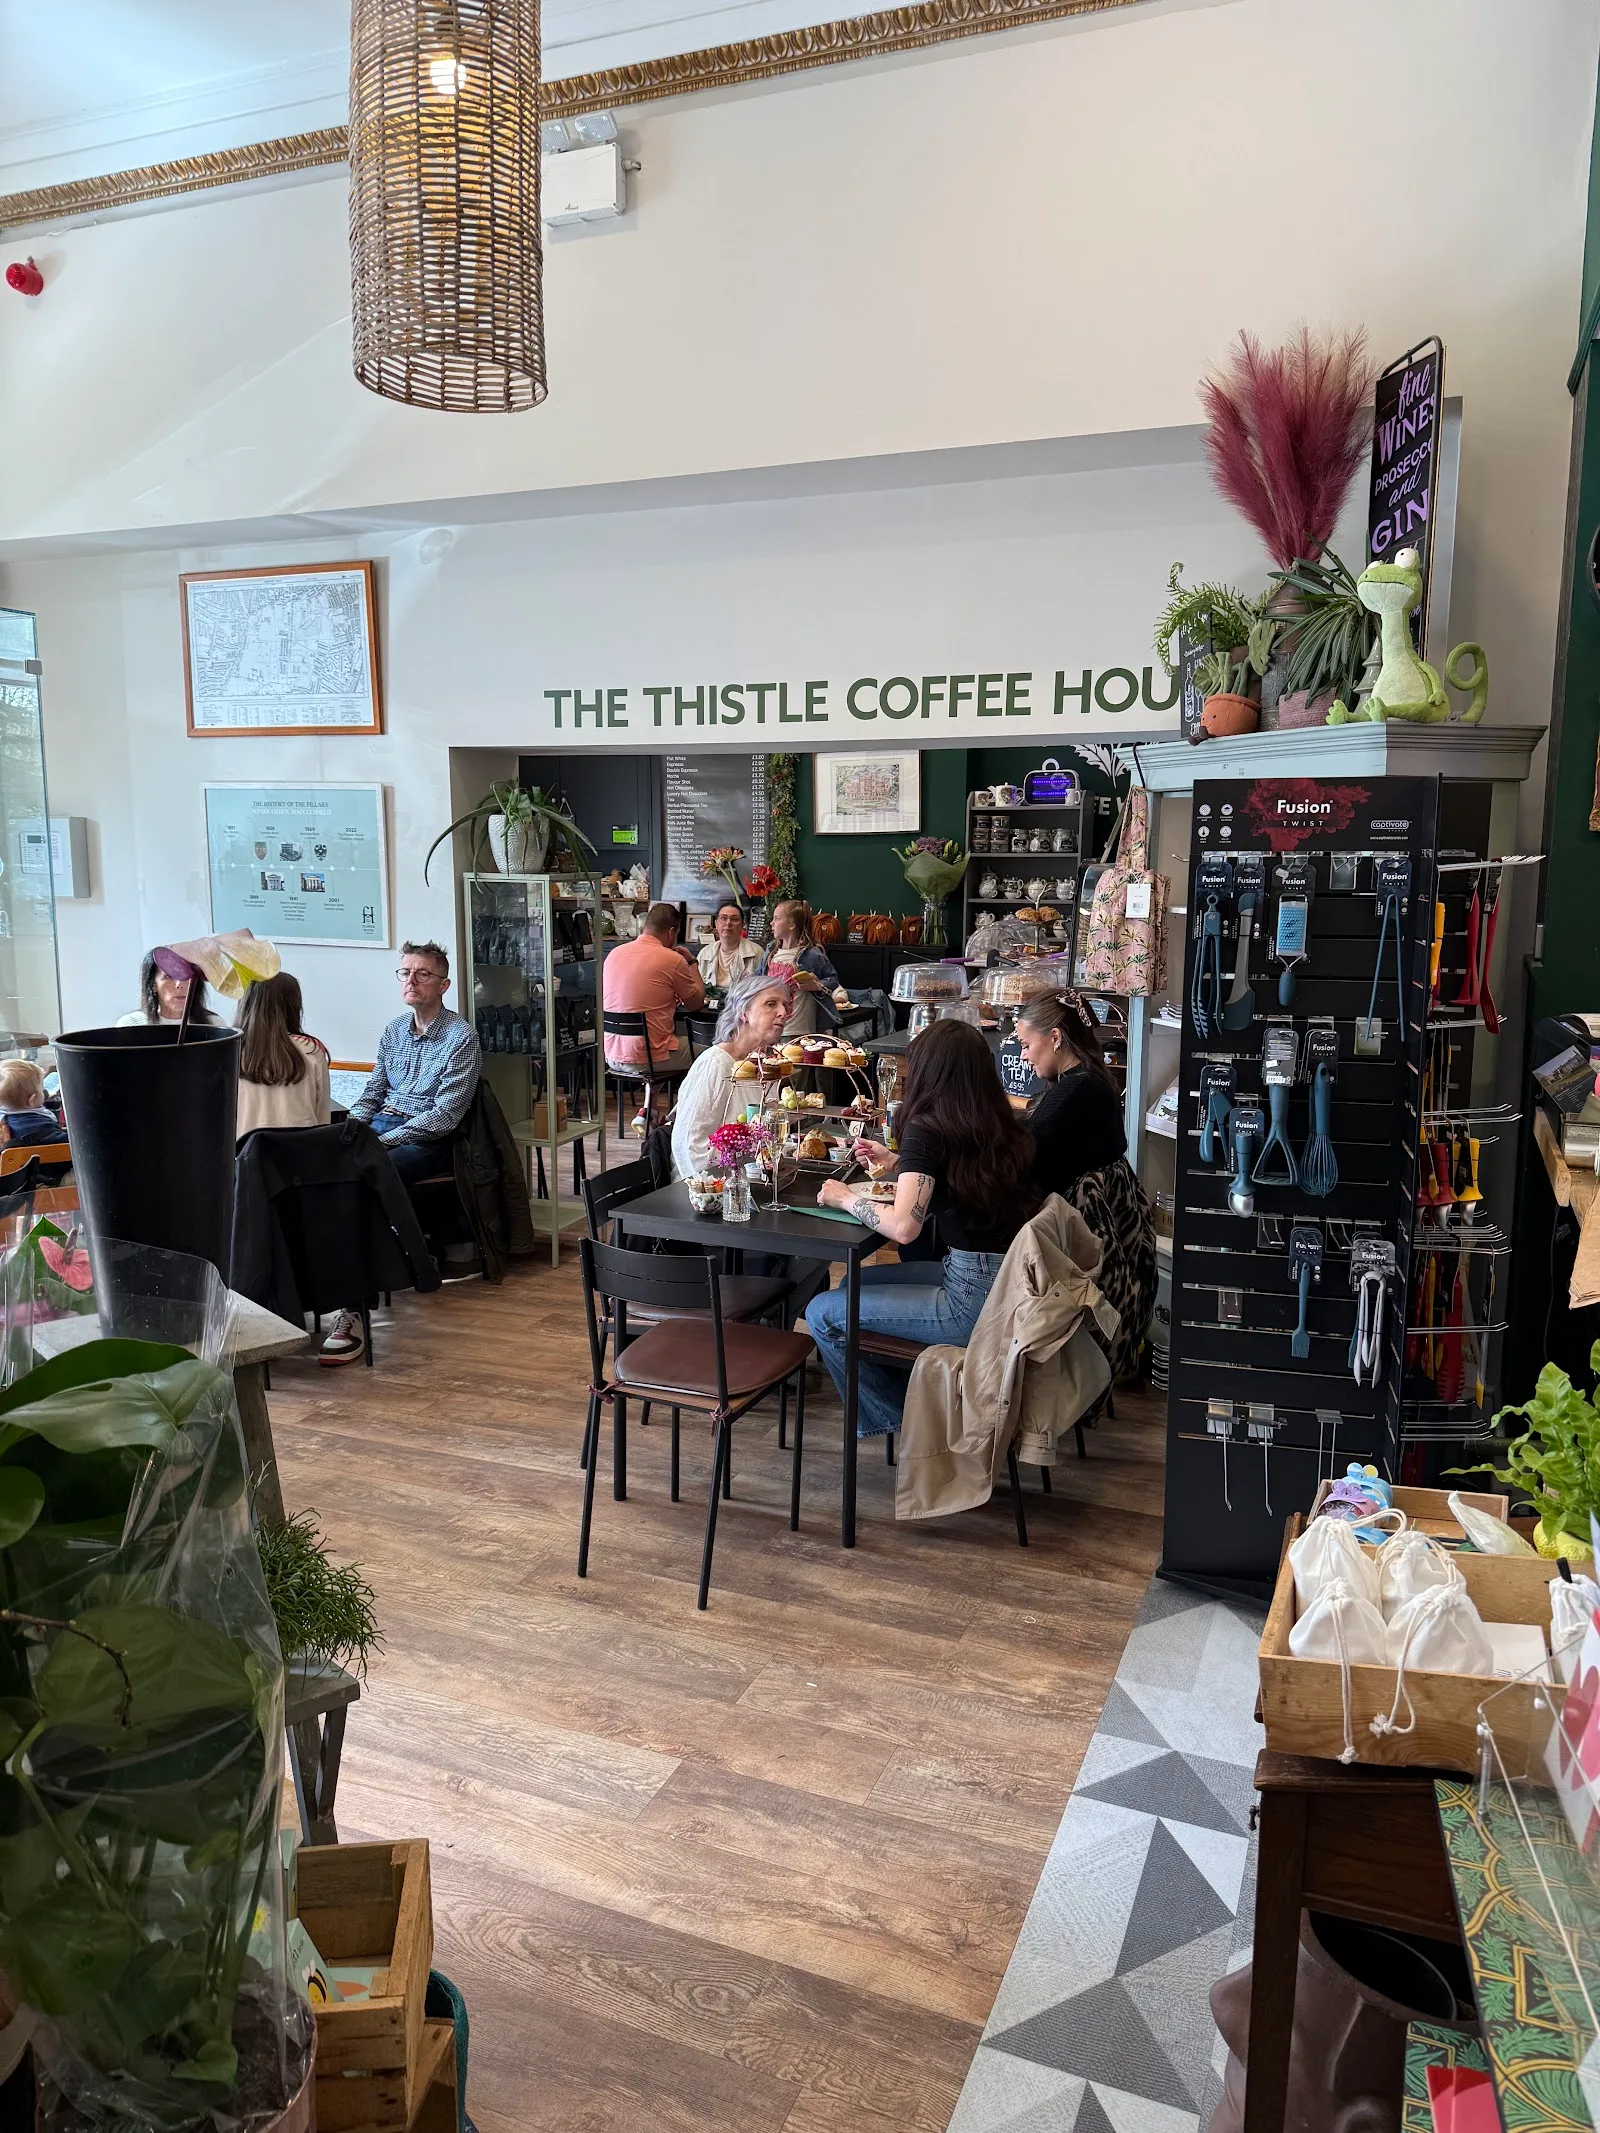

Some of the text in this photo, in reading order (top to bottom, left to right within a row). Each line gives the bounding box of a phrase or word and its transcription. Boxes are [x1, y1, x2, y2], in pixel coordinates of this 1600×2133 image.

[1398, 364, 1430, 419] fine
[1389, 459, 1422, 507] and
[1372, 488, 1428, 553] GIN
[544, 689, 628, 727] THE
[643, 681, 828, 726] THISTLE
[847, 673, 1032, 719] COFFEE
[1277, 799, 1330, 814] Fusion
[1372, 821, 1408, 829] captivate
[1382, 872, 1408, 880] Fusion
[1008, 1067, 1026, 1082] TEA
[1207, 1078, 1230, 1086] Fusion
[1235, 1121, 1258, 1129] Fusion
[1362, 1252, 1386, 1260] Fusion
